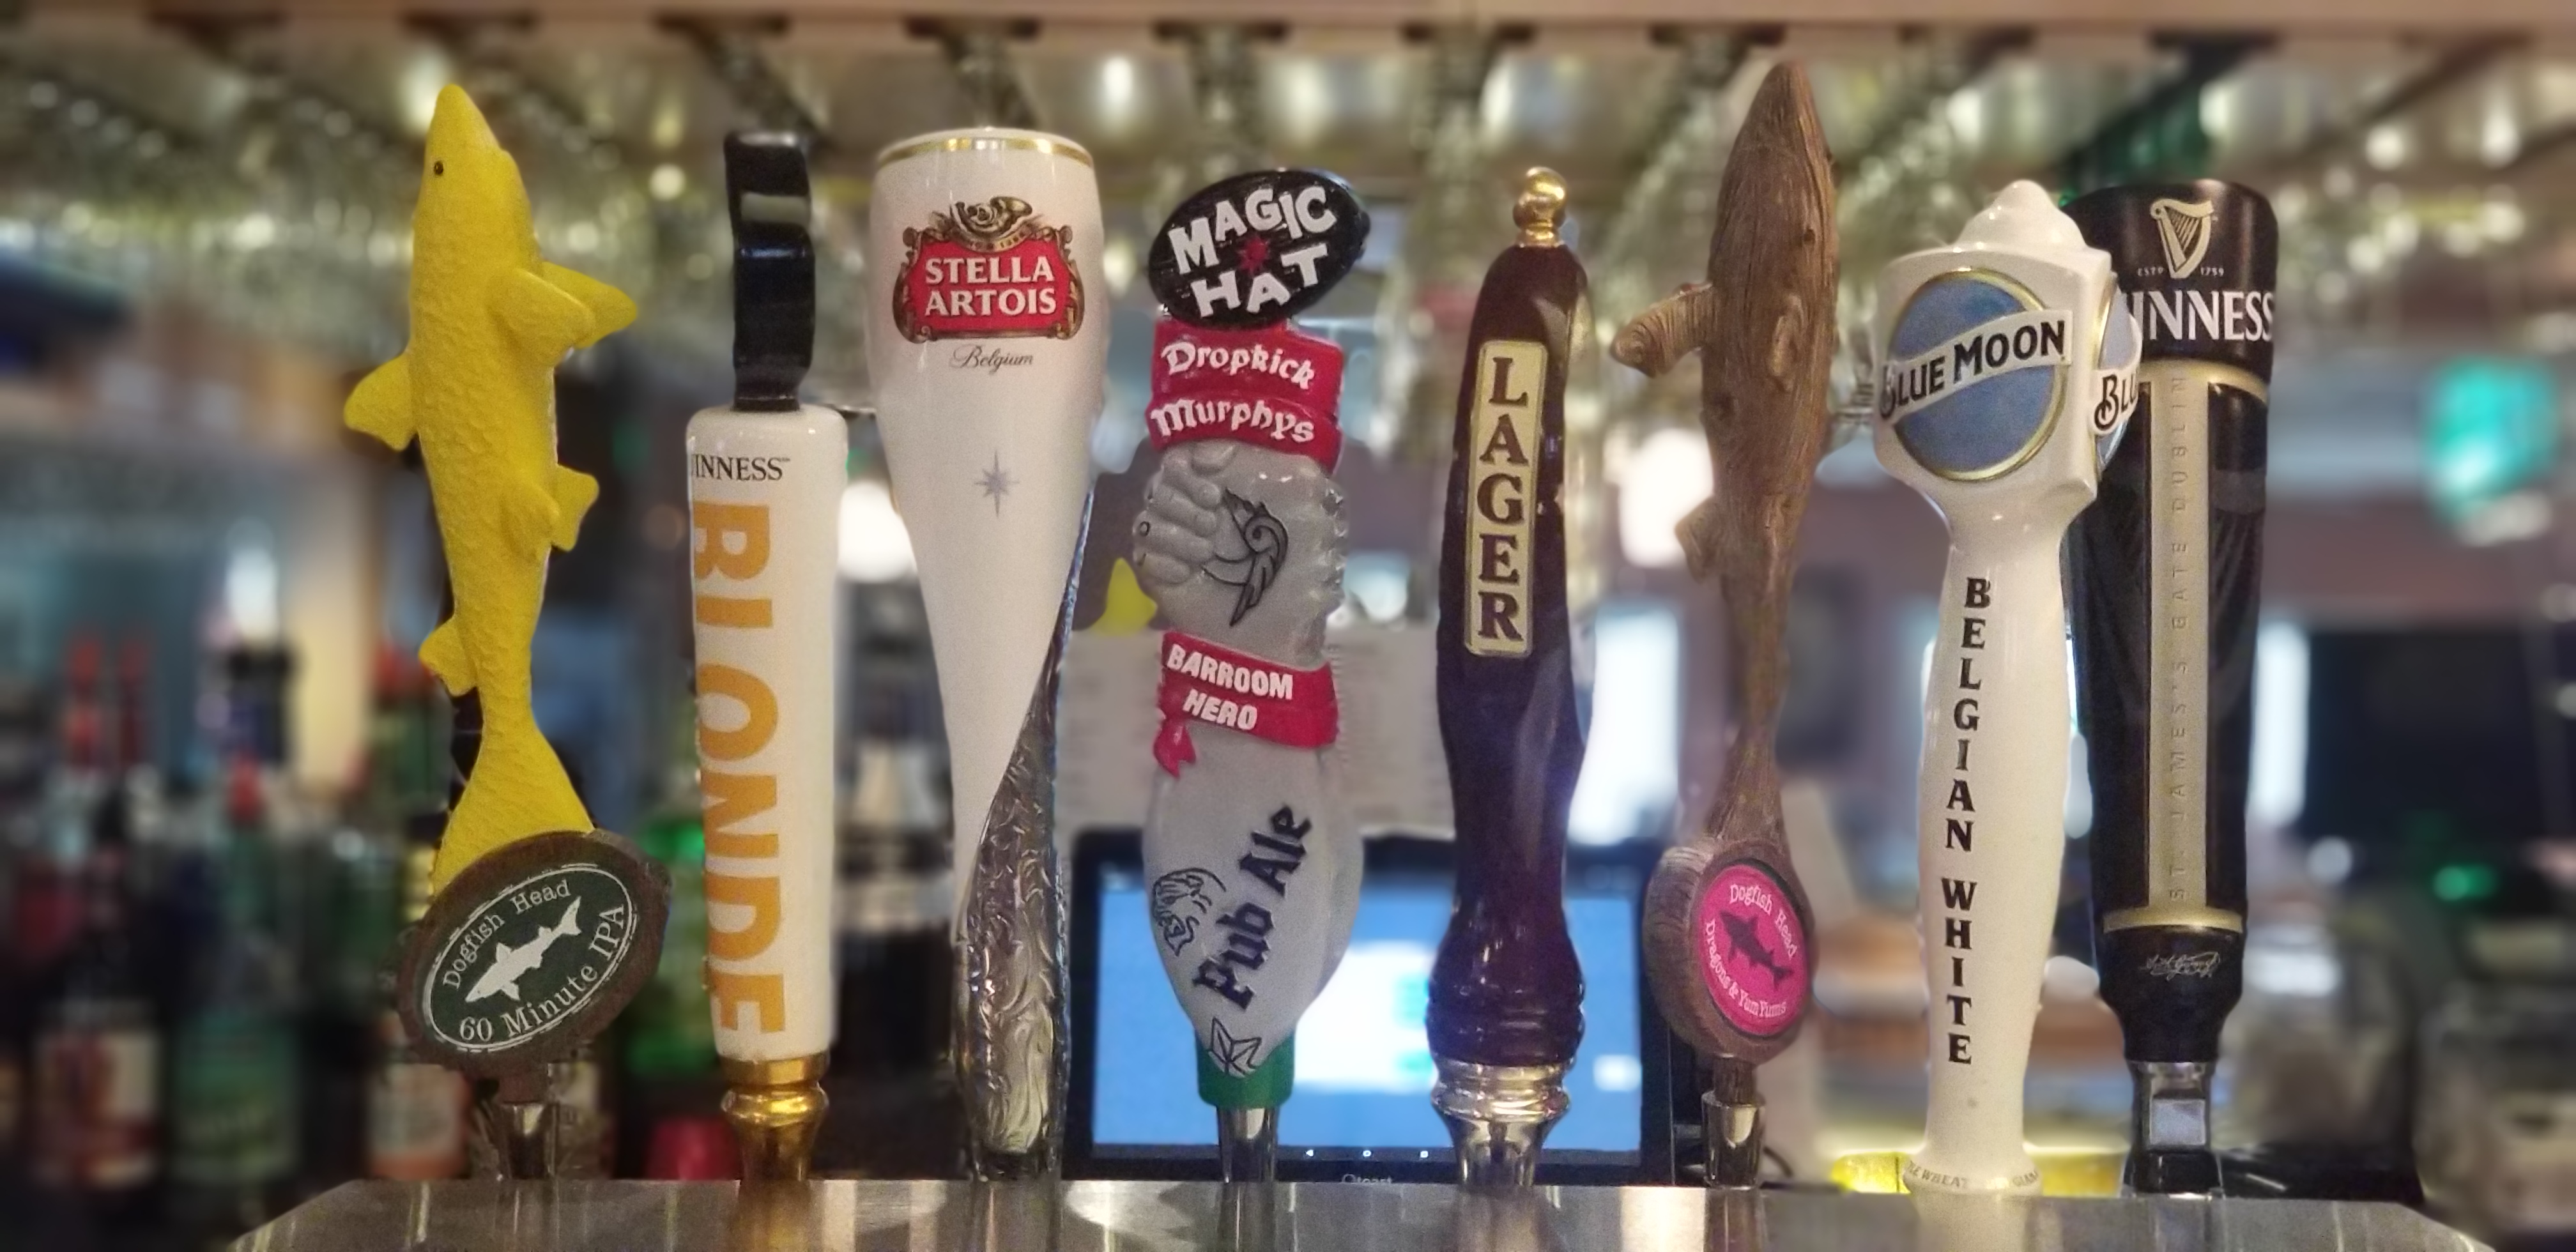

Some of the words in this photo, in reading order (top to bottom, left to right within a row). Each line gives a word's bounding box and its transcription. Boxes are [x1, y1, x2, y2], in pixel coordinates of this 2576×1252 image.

[1168, 186, 1337, 274] MAGIC
[925, 256, 1055, 284] STELLA
[925, 287, 1057, 316] ARTOIS
[1190, 243, 1328, 317] HAT
[2121, 290, 2274, 341] INNESS
[949, 345, 1034, 374] Belgium
[1161, 342, 1314, 389] Dropkick
[1879, 355, 1946, 420] BLUE
[1952, 320, 2066, 385] MOON
[1151, 398, 1314, 443] Murphys
[2094, 374, 2138, 431] BLU
[691, 454, 783, 481] INNESS
[2172, 376, 2188, 513] DUBLIN
[1477, 356, 1529, 641] LAGER
[2172, 542, 2188, 629] GATE
[1167, 644, 1294, 701] BARROOM
[1183, 689, 1257, 731] HERO
[1945, 577, 1991, 852] BELGIAN
[693, 498, 785, 1034] BLONDE
[442, 909, 505, 989] Dogfish
[510, 879, 572, 915] Head
[1193, 901, 1275, 1011] Pub
[1239, 804, 1312, 896] Ale
[1729, 884, 1773, 915] Dogfish
[1774, 908, 1798, 960] Head
[459, 1016, 493, 1042] 60
[501, 962, 599, 1039] Minute
[588, 904, 625, 961] IPA
[1705, 919, 1732, 989] Dragons
[1941, 878, 1977, 1065] WHITE
